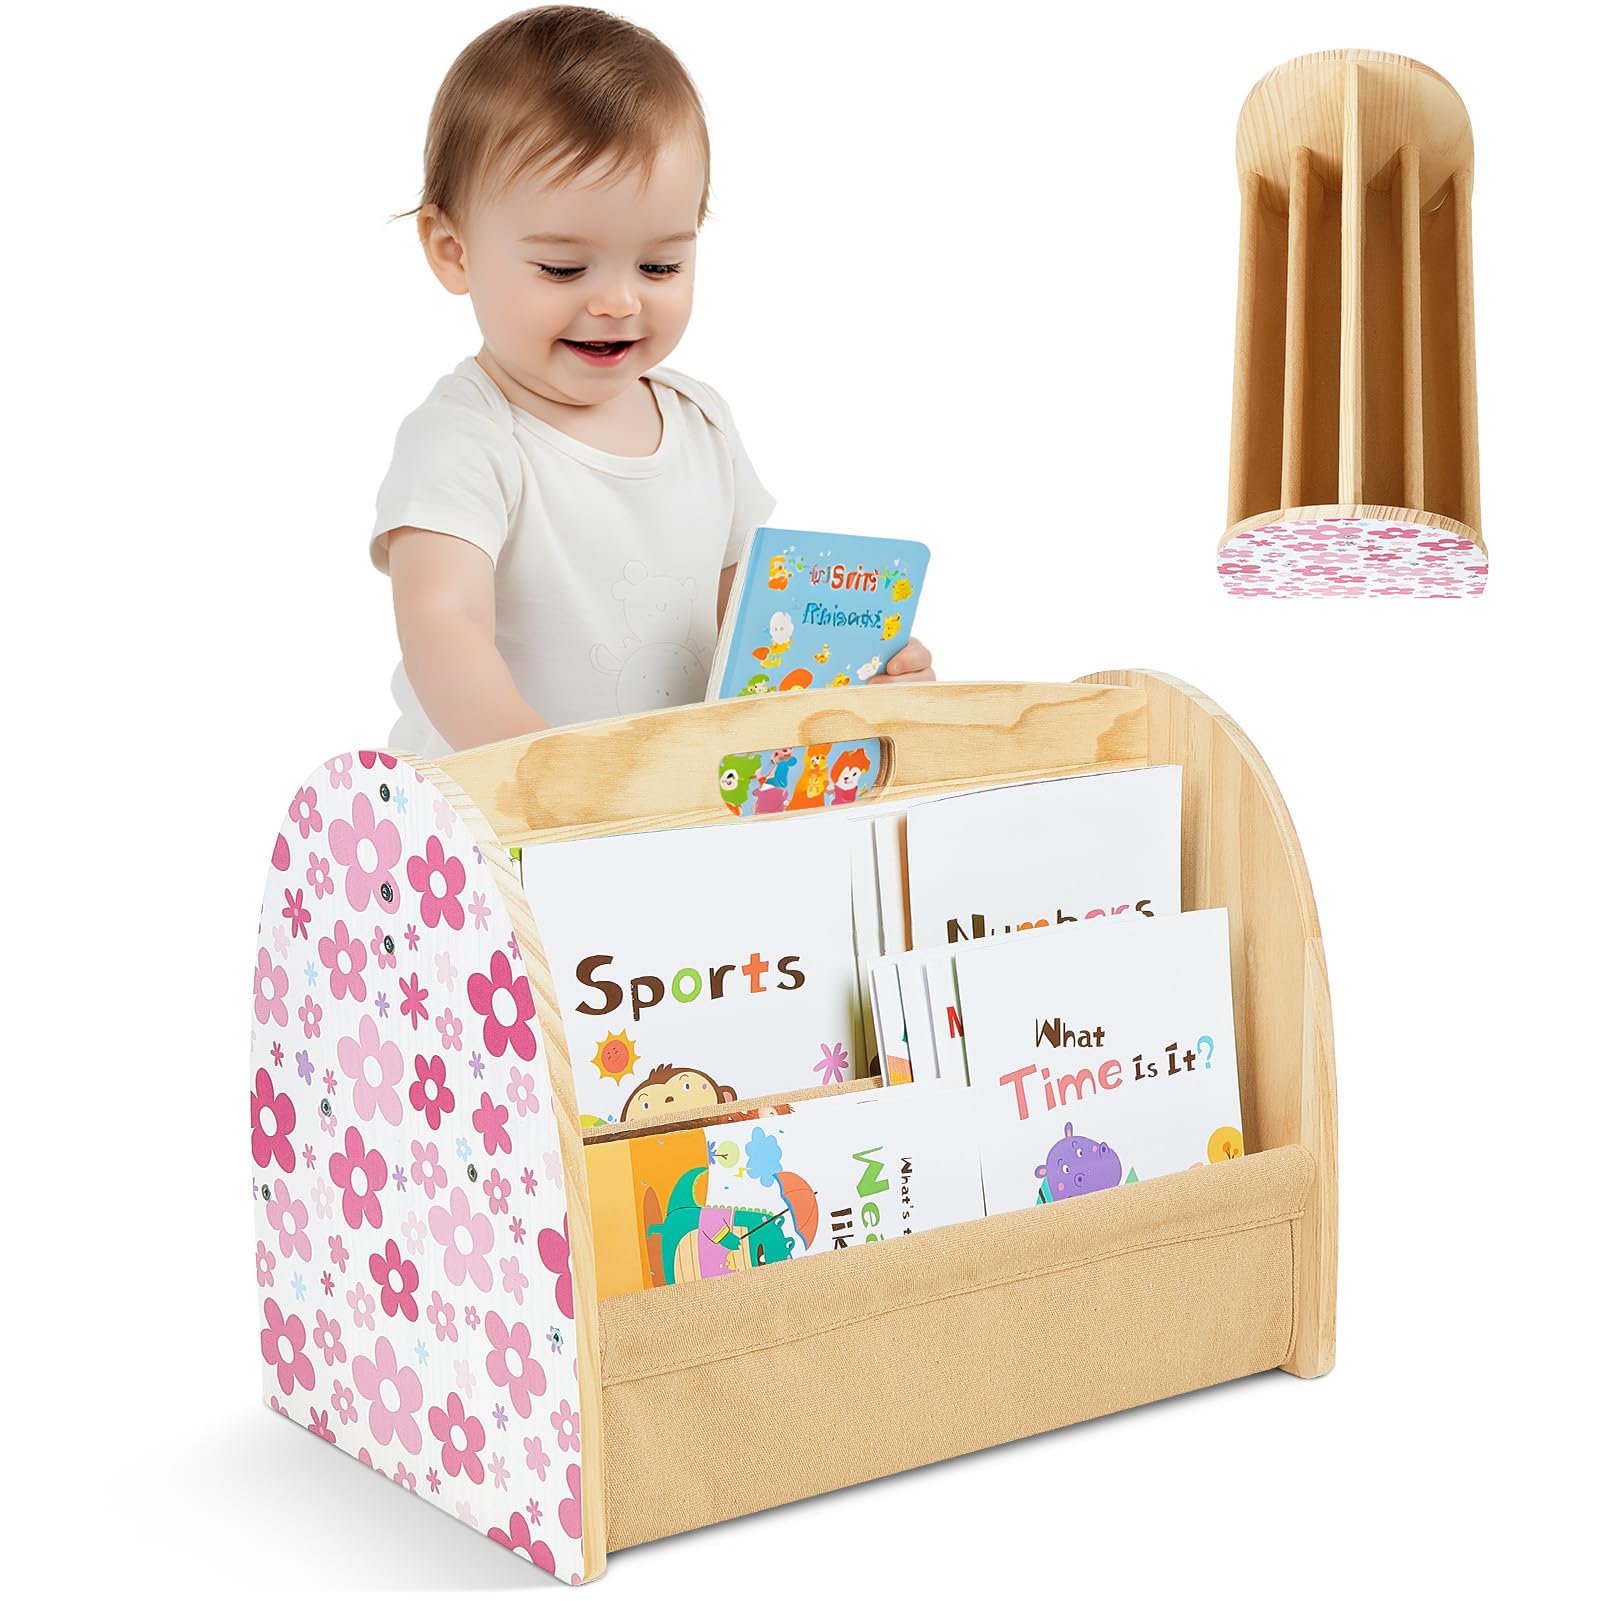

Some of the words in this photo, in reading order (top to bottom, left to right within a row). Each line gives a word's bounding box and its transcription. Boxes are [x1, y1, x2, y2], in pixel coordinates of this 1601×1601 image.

[575, 952, 805, 1022] Sports
[1035, 1017, 1105, 1049] What
[999, 1059, 1123, 1120] Time
[900, 1156, 914, 1220] What's
